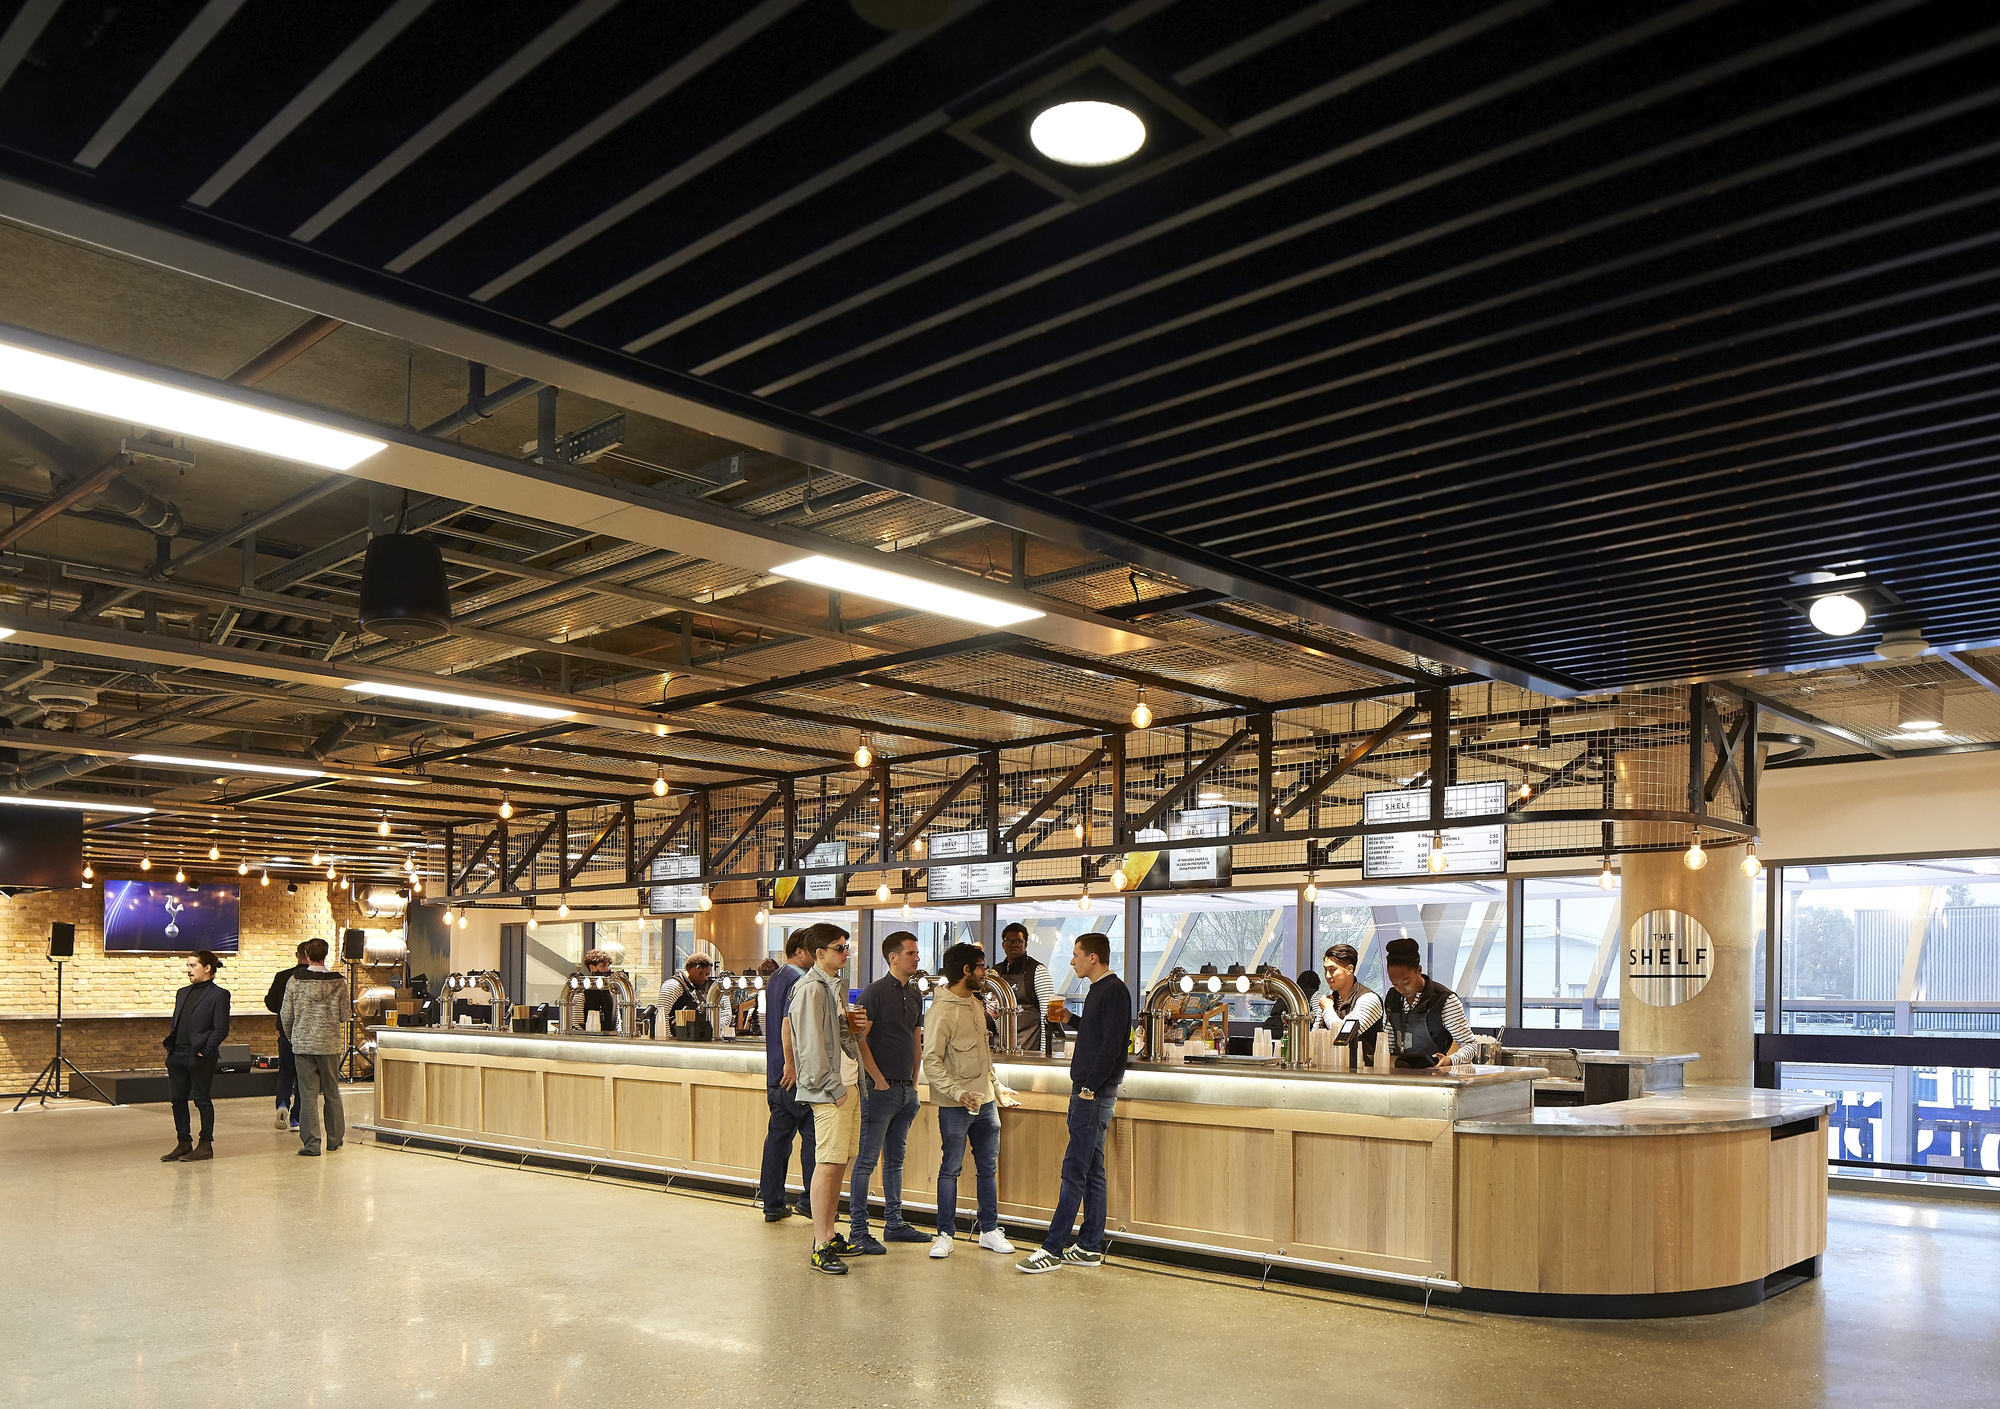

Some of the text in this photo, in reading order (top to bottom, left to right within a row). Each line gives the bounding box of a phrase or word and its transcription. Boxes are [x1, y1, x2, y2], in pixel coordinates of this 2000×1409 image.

[1385, 801, 1410, 811] SHELF
[1653, 933, 1674, 941] THE
[1629, 948, 1707, 966] SHELF
